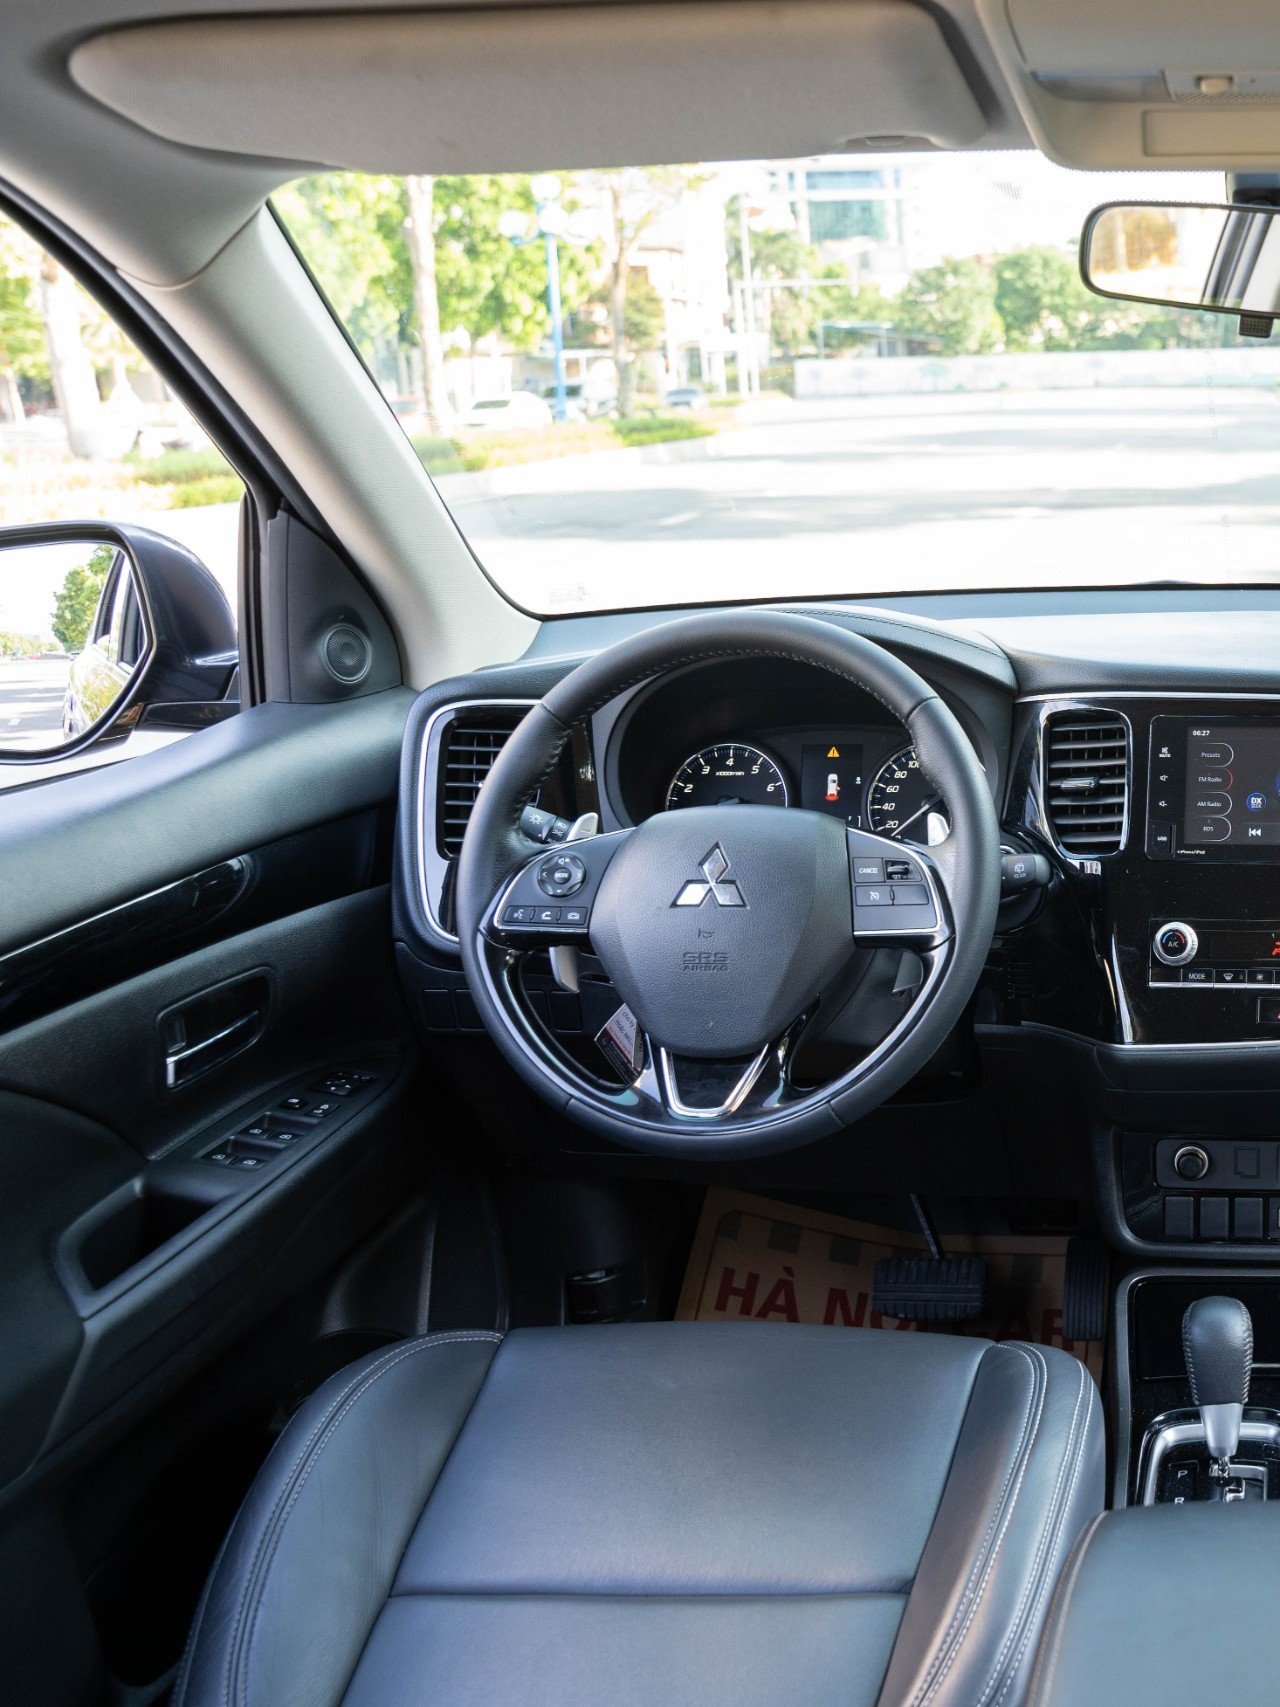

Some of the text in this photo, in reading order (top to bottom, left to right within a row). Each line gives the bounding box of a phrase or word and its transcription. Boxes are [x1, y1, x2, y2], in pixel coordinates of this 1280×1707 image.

[726, 758, 734, 766] 4
[701, 766, 710, 775] 3
[751, 765, 760, 774] 5
[894, 771, 907, 779] 80
[684, 784, 693, 793] 2
[767, 783, 775, 792] 6
[886, 785, 900, 793] 60
[882, 802, 895, 810] 40
[885, 820, 899, 828] 20
[683, 952, 730, 964] SRS
[714, 1265, 800, 1322] HÀ
[1177, 1470, 1188, 1478] P
[1175, 1497, 1184, 1505] R
